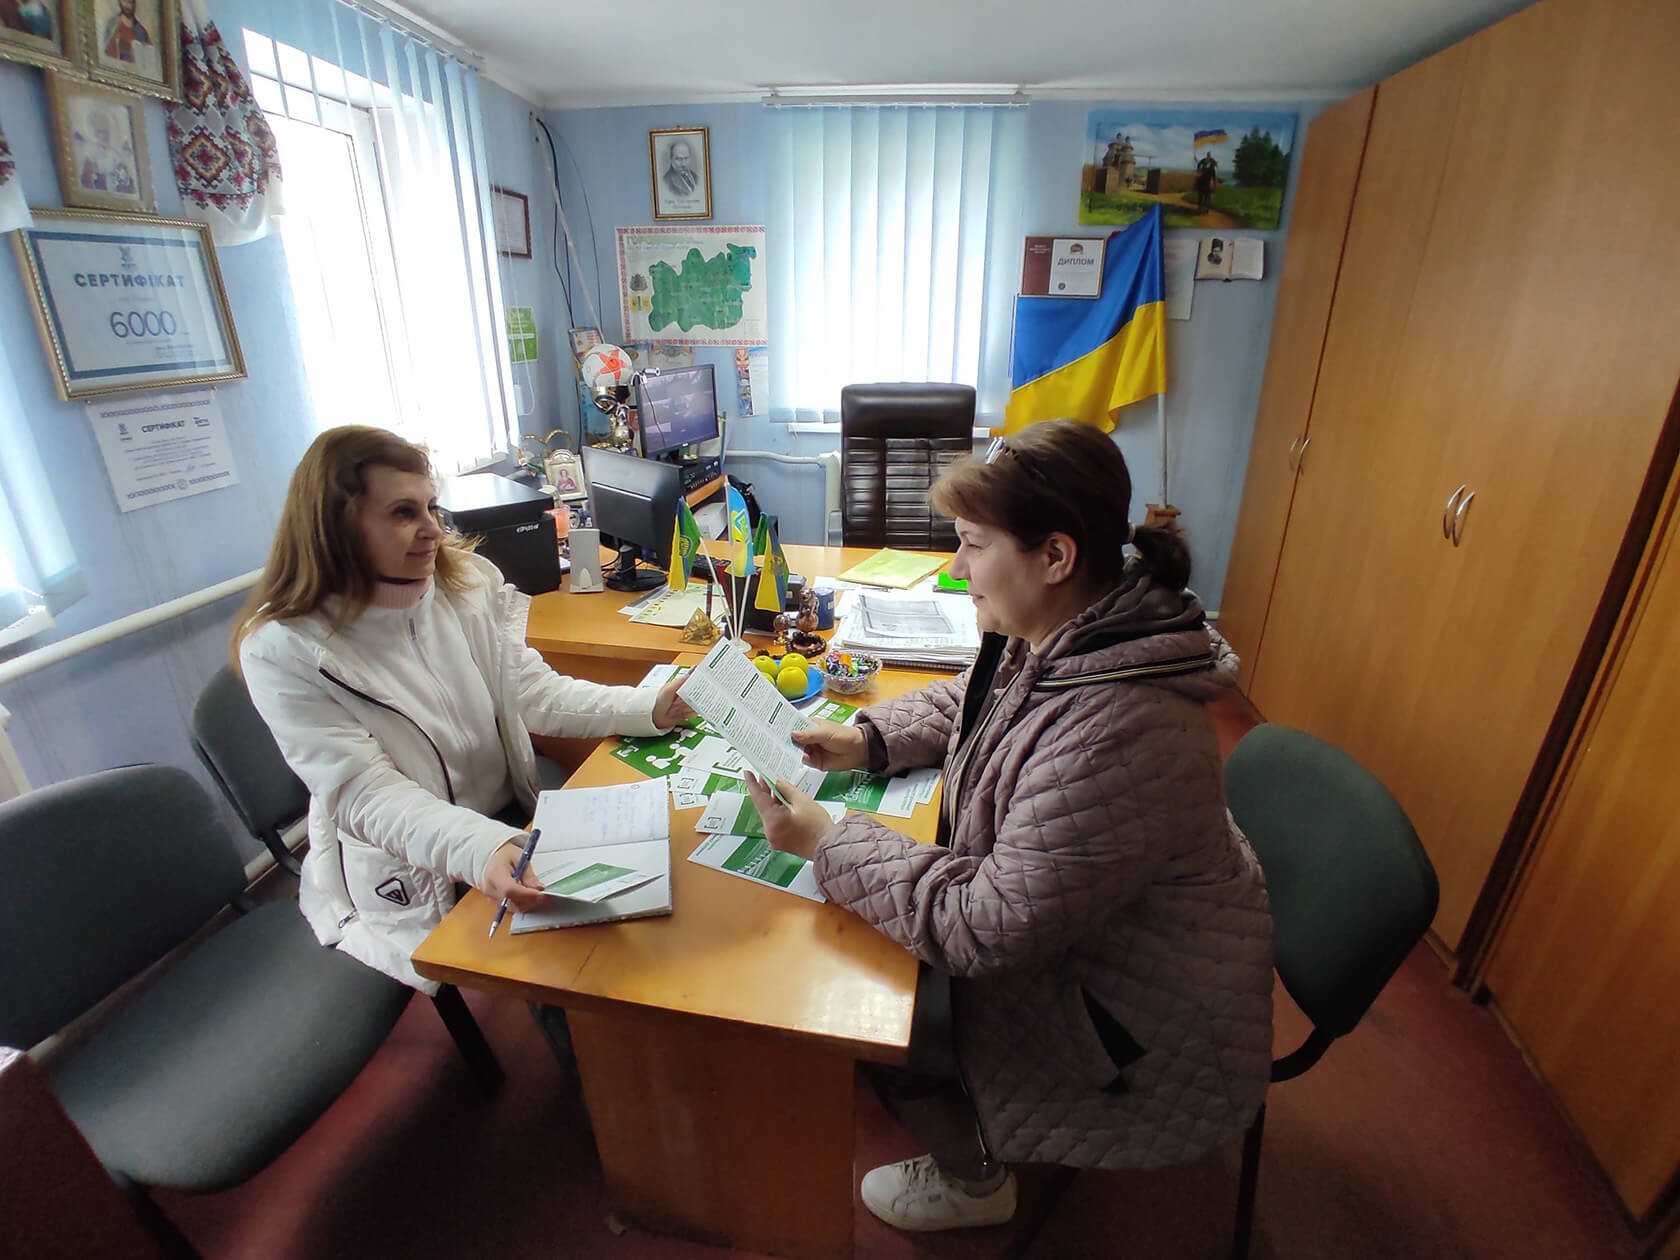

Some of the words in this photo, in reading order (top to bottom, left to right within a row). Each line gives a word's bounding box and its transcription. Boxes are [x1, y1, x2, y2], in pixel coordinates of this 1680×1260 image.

[1057, 257, 1095, 266] ДИПЛОМ
[73, 273, 185, 287] СЕРТИФІКАТ
[110, 311, 176, 338] 6000
[141, 419, 185, 433] СЕРТИФІКАТ
